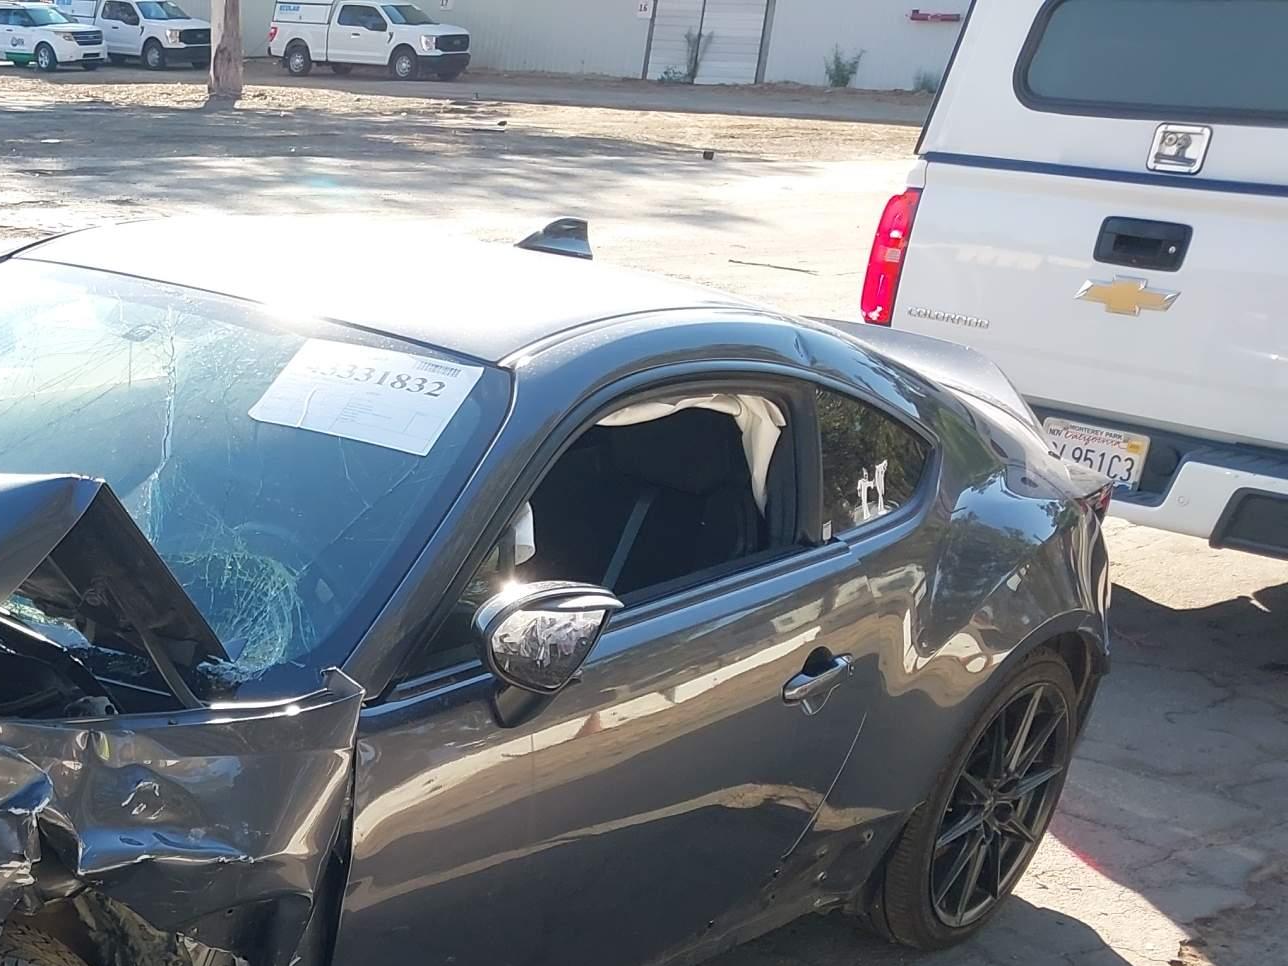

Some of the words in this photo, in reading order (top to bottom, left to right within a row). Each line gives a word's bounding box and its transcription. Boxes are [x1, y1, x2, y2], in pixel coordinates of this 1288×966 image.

[907, 307, 990, 329] COLORADO
[1064, 429, 1125, 449] California
[1105, 431, 1123, 440] PARK
